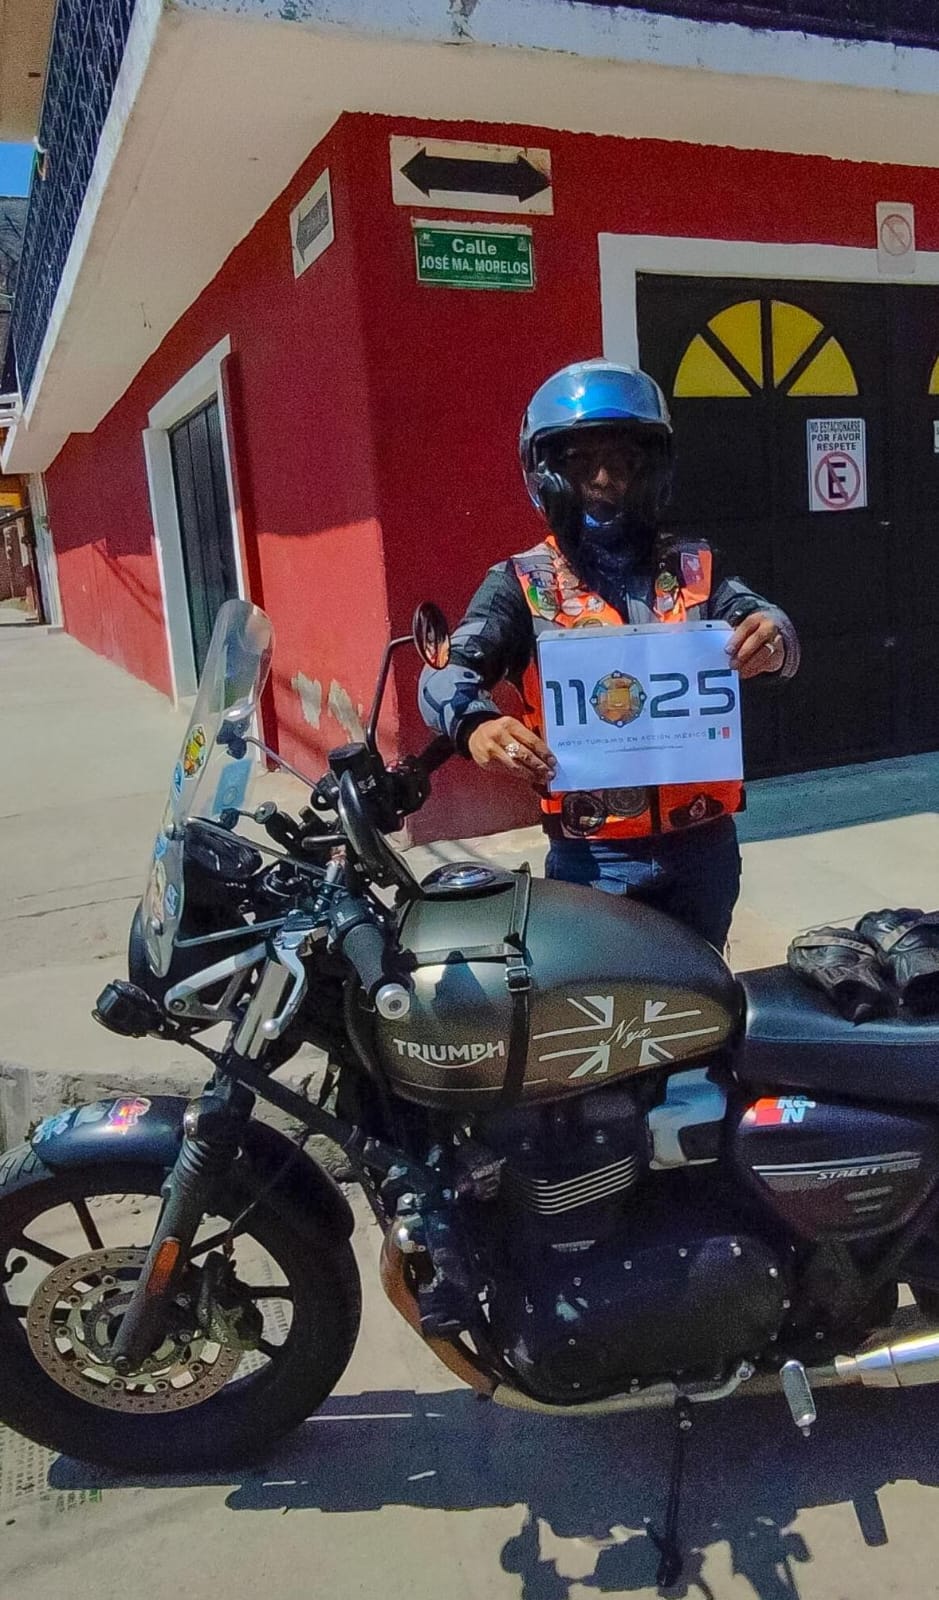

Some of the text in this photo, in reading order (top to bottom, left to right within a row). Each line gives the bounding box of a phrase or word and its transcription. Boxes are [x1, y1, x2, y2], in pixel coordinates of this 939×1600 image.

[451, 238, 497, 255] Calle
[421, 254, 529, 274] JOSÉ MA. MORELOS
[811, 432, 861, 442] POR FAVOR
[816, 442, 857, 451] RESPETE
[557, 738, 583, 748] MOTO
[586, 736, 624, 745] TURISMO
[626, 735, 639, 743] EN
[393, 1038, 506, 1067] TRIUMPH
[817, 1166, 880, 1180] STREET
